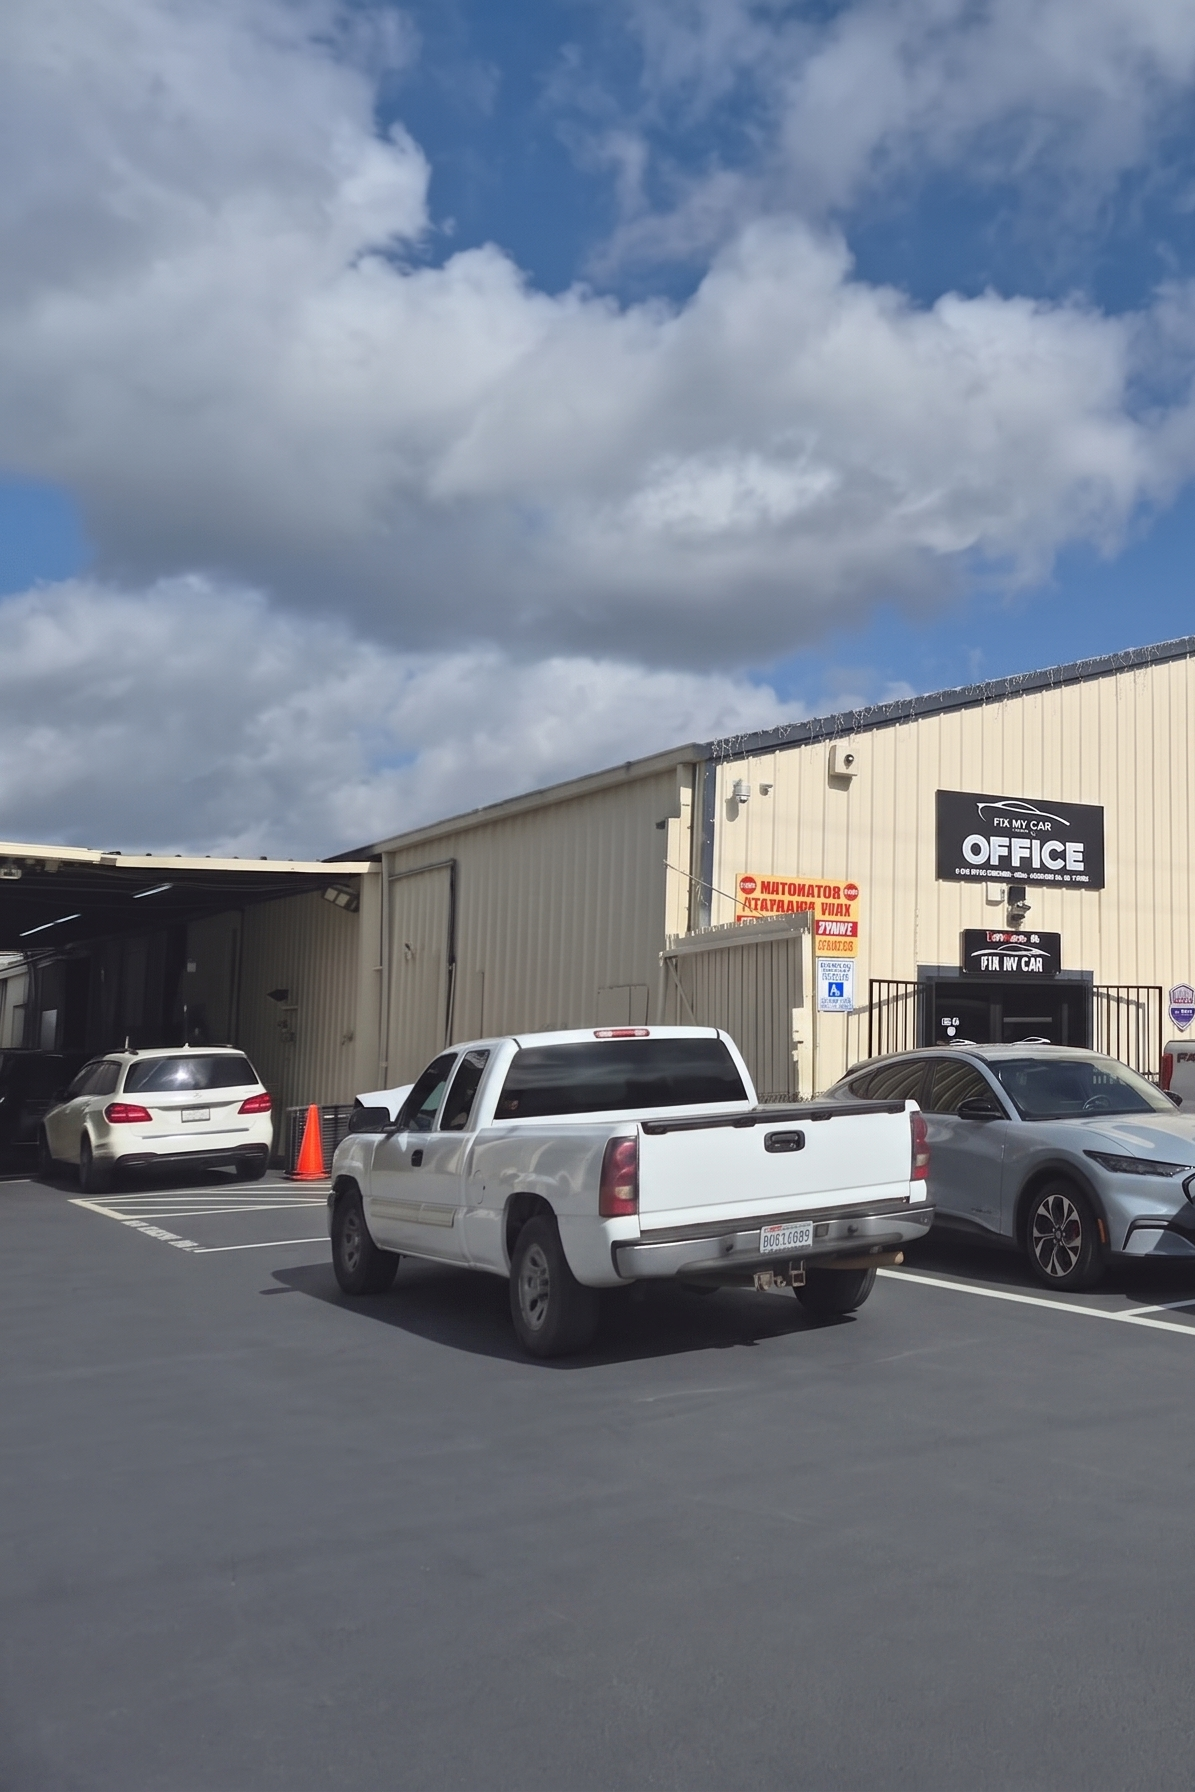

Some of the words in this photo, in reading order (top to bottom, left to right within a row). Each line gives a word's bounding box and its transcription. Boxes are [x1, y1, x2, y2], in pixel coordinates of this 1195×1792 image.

[1011, 819, 1028, 830] MY
[1030, 822, 1052, 832] CAR
[962, 834, 1085, 871] OFFICE
